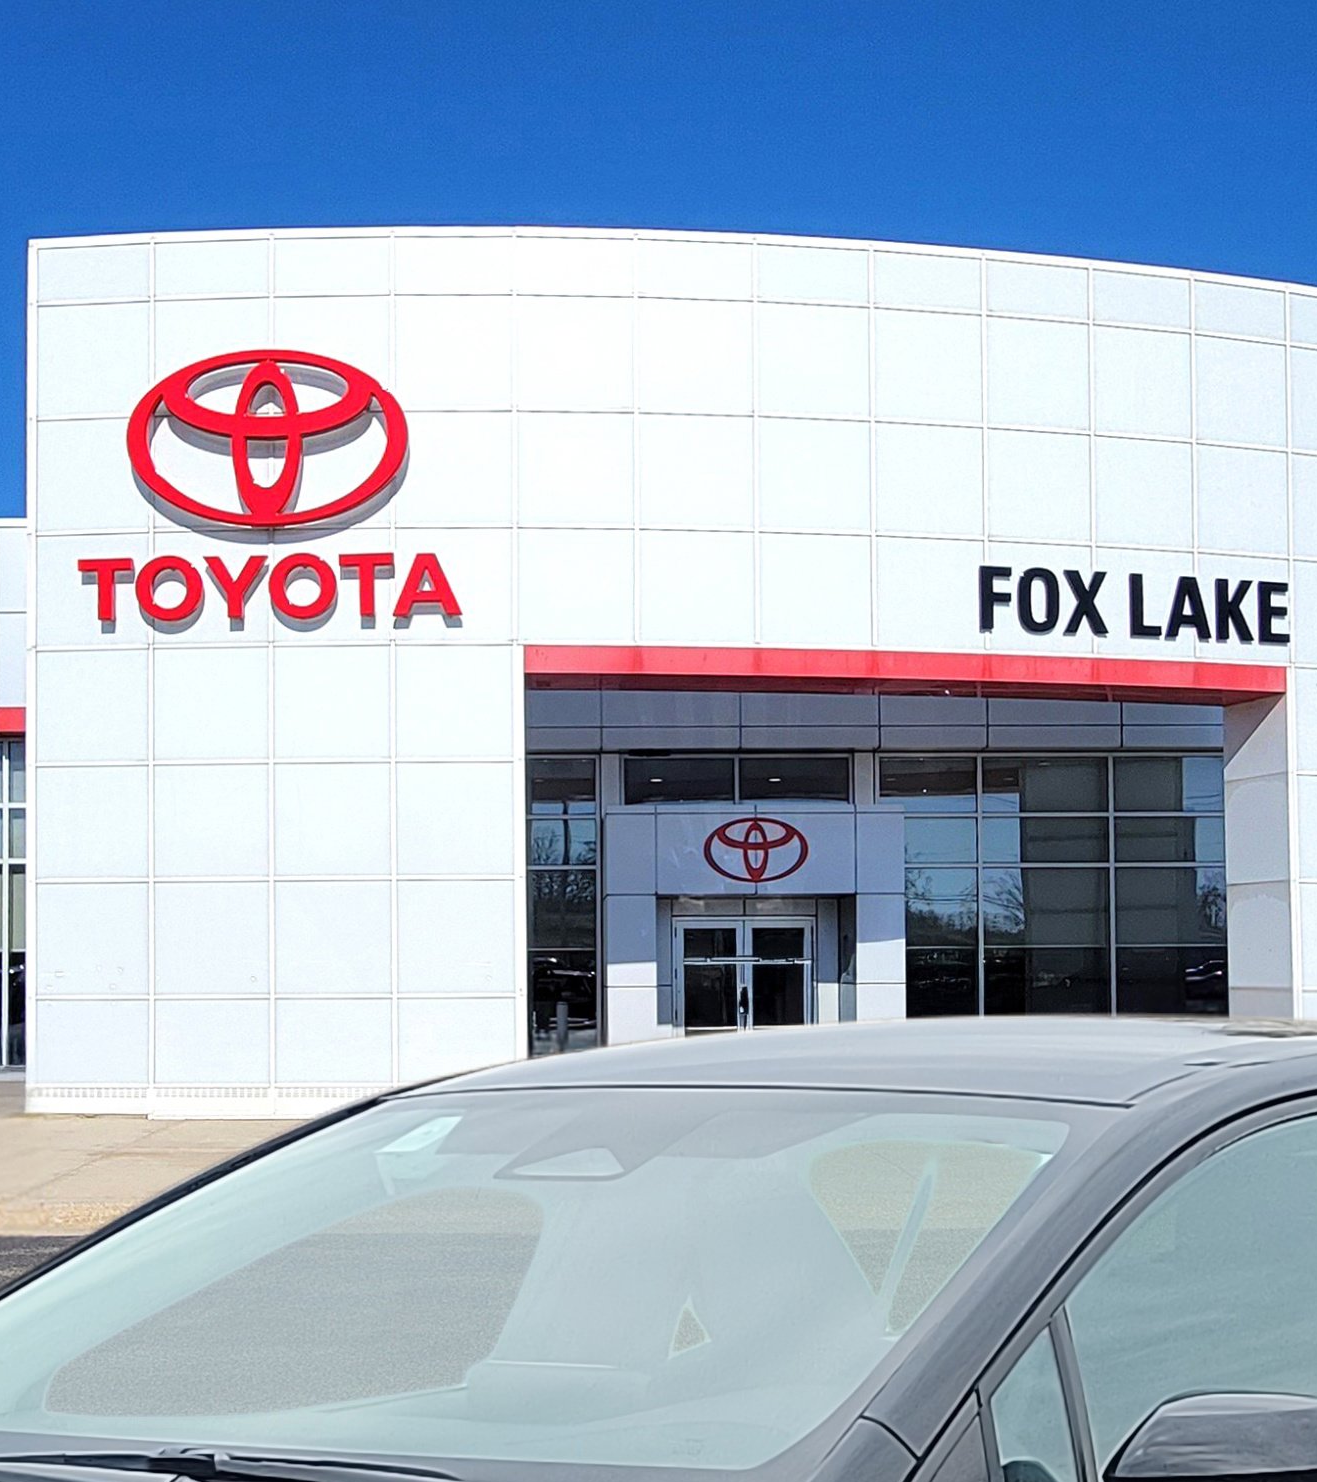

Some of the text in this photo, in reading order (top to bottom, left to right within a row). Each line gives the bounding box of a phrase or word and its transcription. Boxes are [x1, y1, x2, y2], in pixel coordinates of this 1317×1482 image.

[78, 553, 463, 624] TOYOTA
[979, 565, 1290, 644] FOX LAKE
